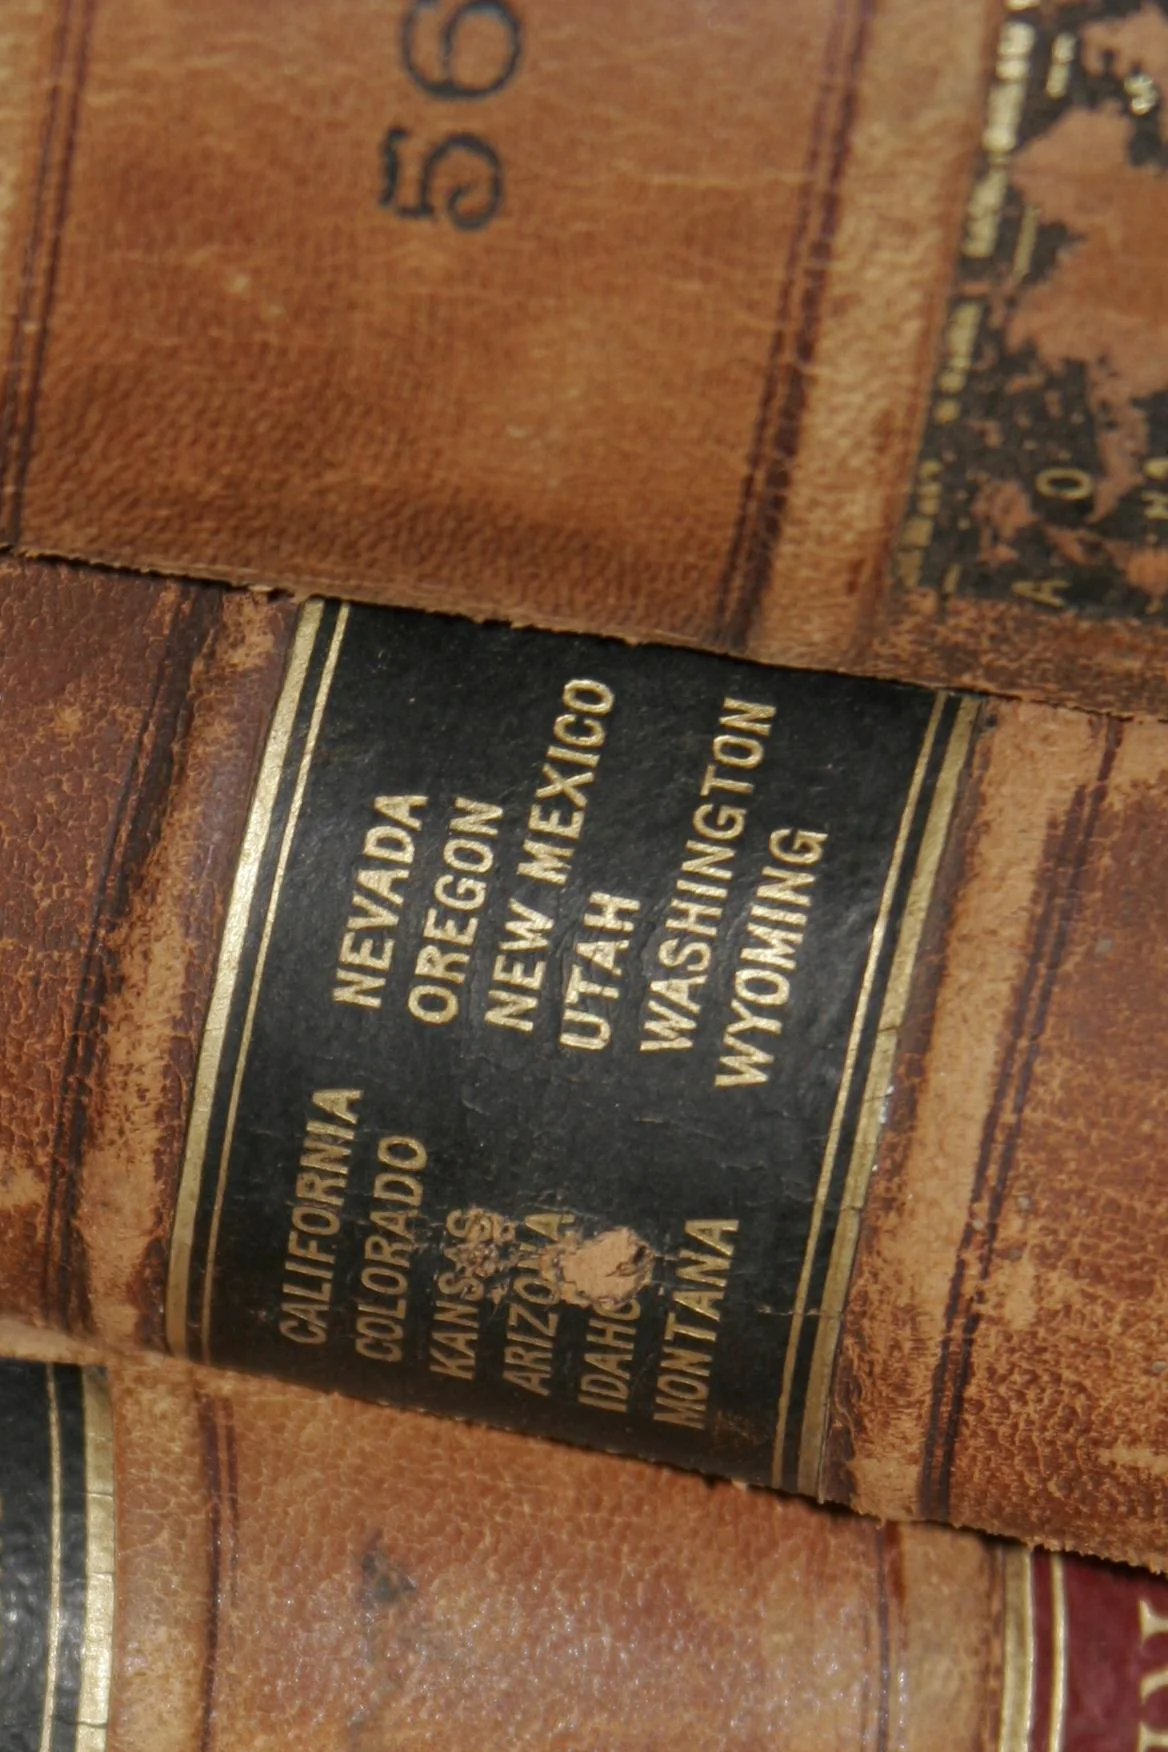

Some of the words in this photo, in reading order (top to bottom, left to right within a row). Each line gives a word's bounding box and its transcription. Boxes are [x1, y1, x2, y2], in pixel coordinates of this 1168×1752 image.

[378, 0, 524, 231] 56
[517, 678, 615, 886] MEXICO
[640, 697, 776, 1052] WASHINGTON
[334, 794, 428, 1008] NEVADA
[408, 797, 504, 1024] OREGON
[484, 898, 555, 1032] NEW
[559, 891, 640, 1052] UTAH
[715, 827, 828, 1087] WYOMING
[279, 1088, 364, 1346] CALIFORNIA
[355, 1135, 427, 1363] COLORADO
[653, 1219, 740, 1430] MONTANA
